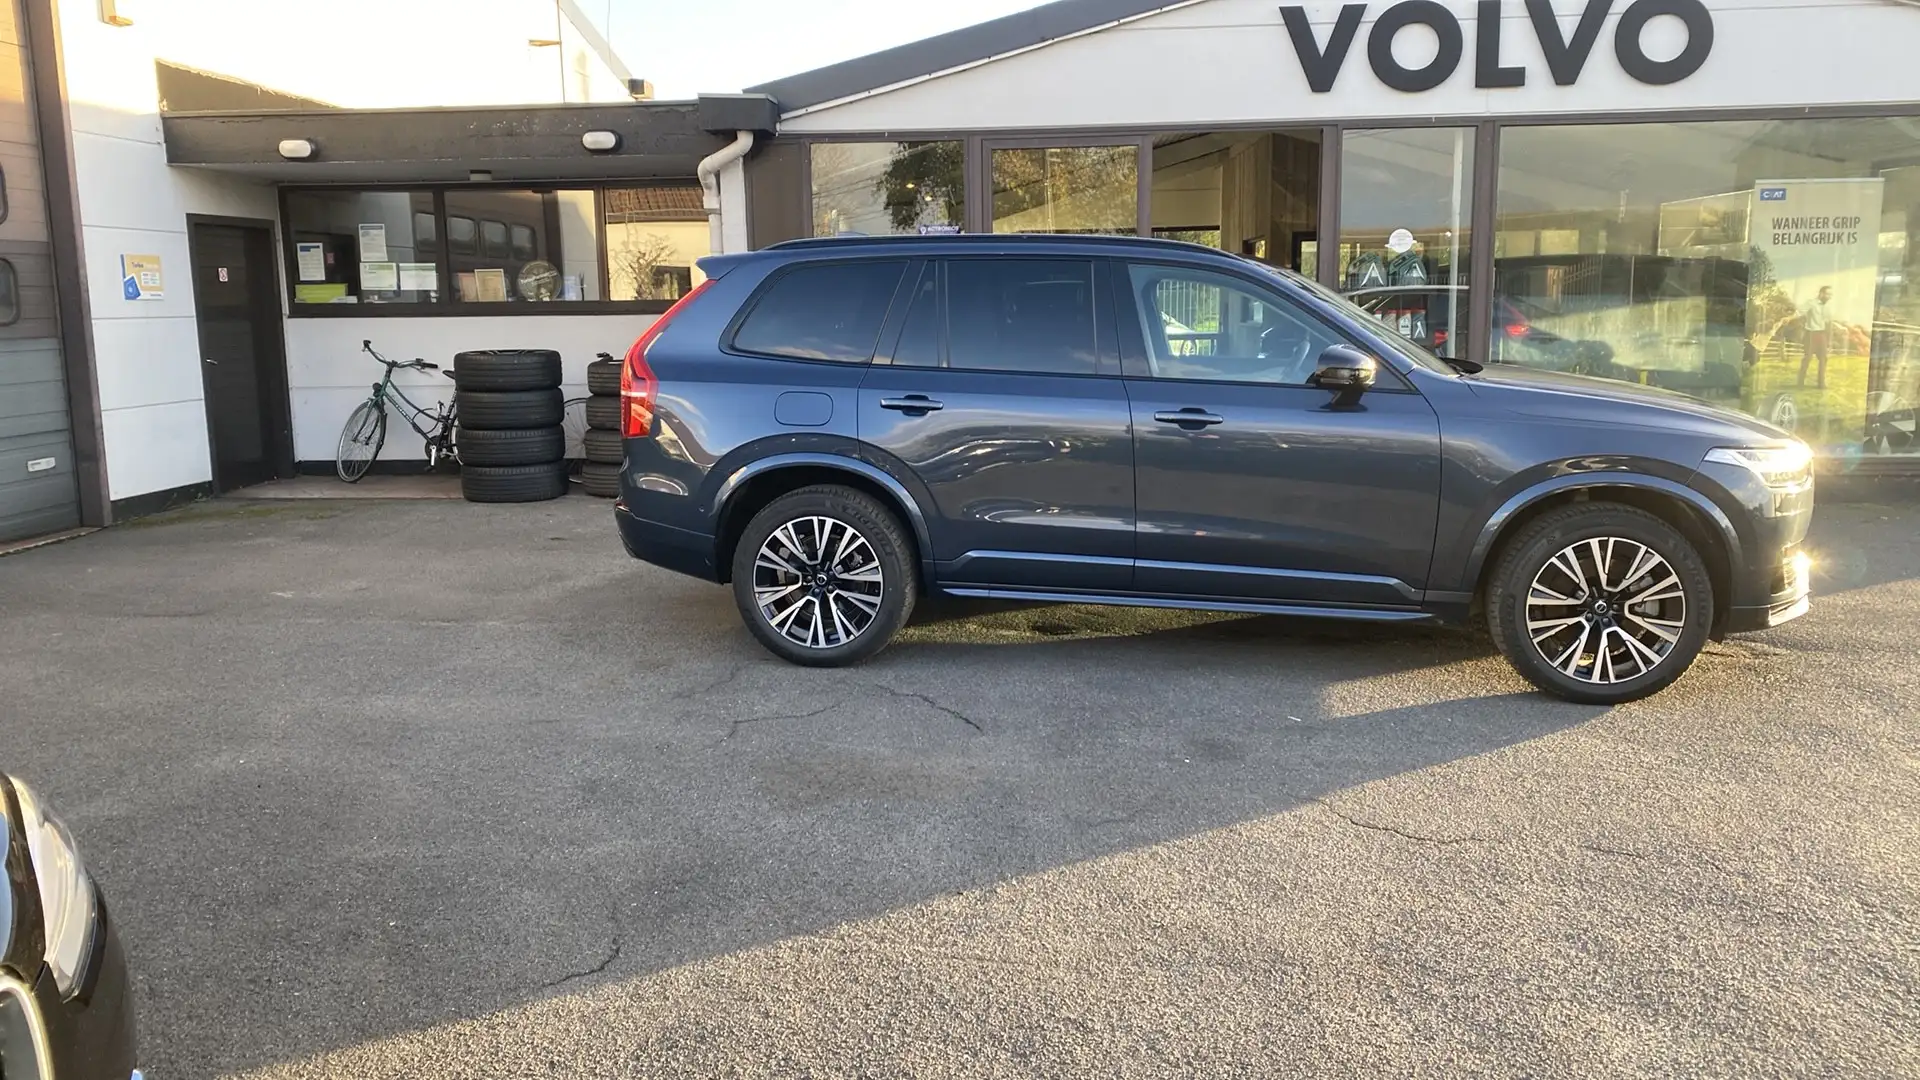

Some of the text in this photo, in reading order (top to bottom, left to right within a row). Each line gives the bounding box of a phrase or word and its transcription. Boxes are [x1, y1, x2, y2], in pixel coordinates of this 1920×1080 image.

[1278, 0, 1714, 93] VOLVO
[1762, 190, 1784, 198] CAT
[1771, 216, 1861, 230] WANNEER GRIP
[1772, 231, 1858, 245] BELANGRIJK IS
